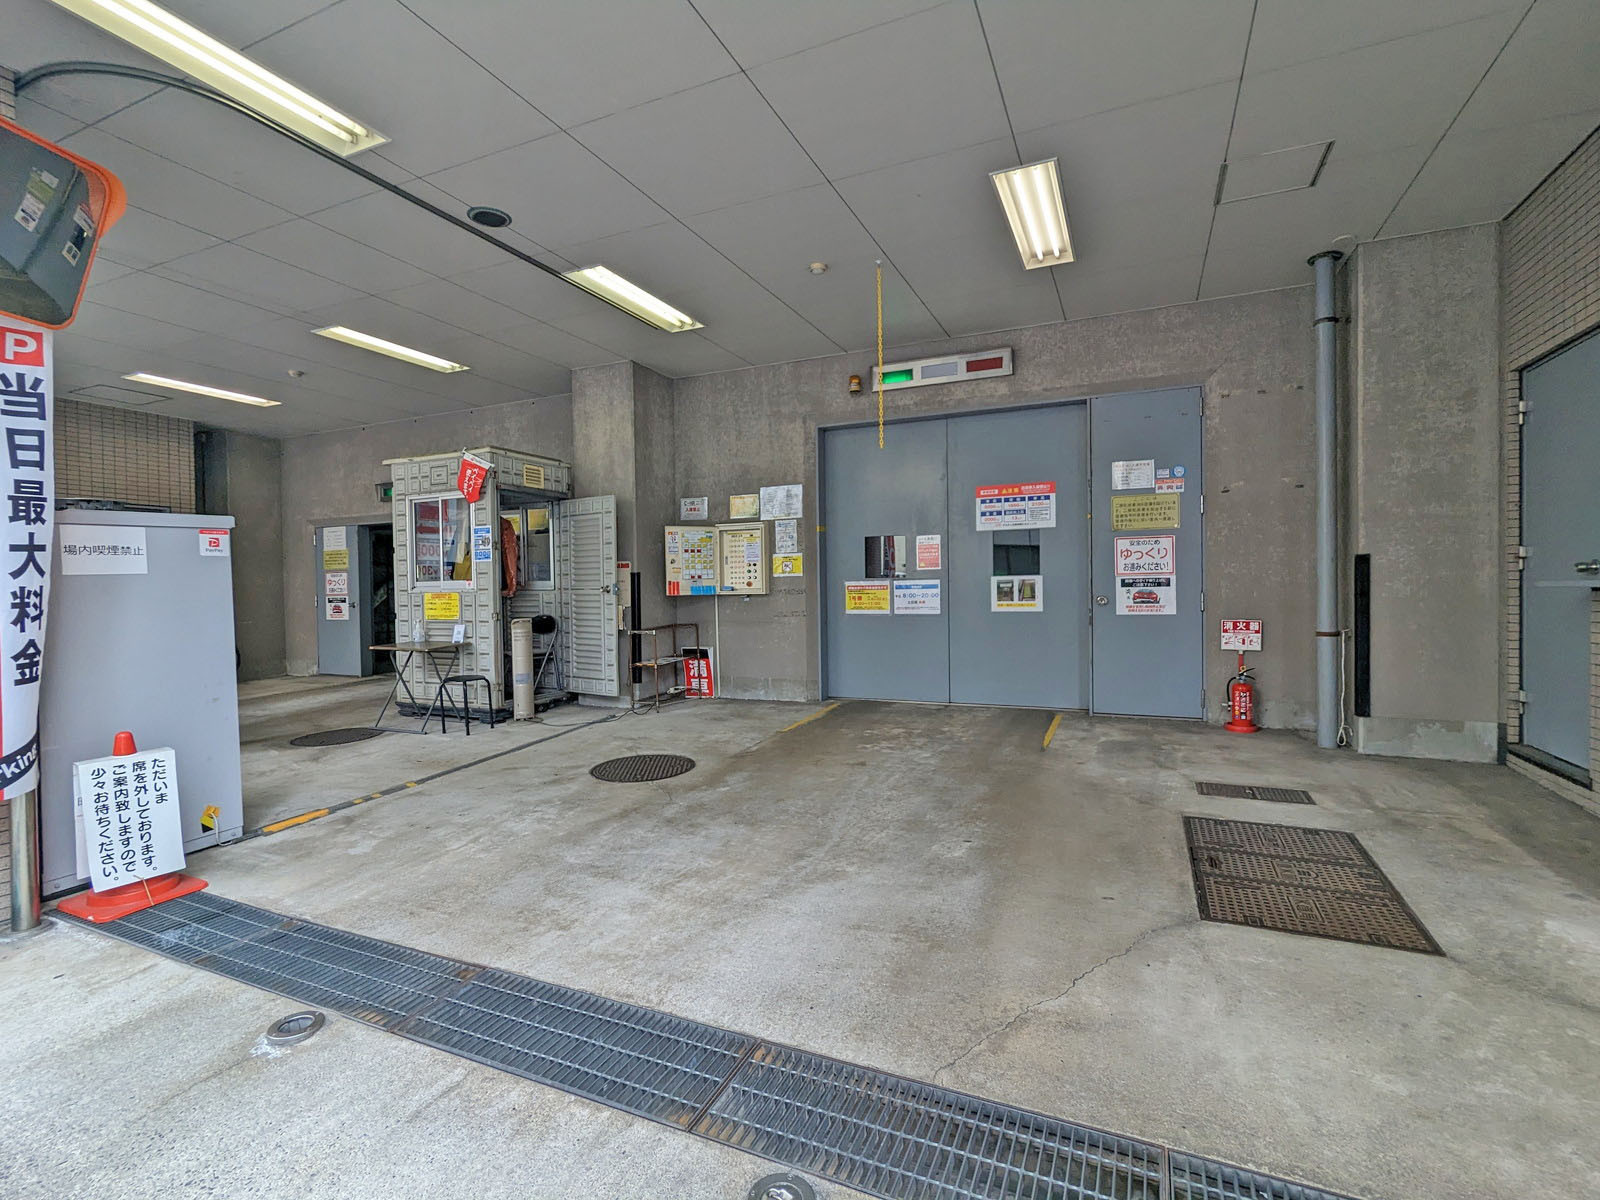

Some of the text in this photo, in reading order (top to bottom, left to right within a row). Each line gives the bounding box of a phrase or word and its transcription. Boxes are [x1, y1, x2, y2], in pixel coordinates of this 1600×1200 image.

[4, 335, 38, 360] P
[0, 371, 48, 687] 当日最大料金
[63, 544, 144, 556] 場内喫煙禁止
[1120, 547, 1168, 560] ゆっくり
[1224, 622, 1260, 630] 消火器
[0, 743, 37, 779] kin
[151, 758, 169, 804] ただいま
[90, 767, 119, 881] 少々お待ちください。
[112, 764, 137, 872] ご案内致しますので
[131, 761, 159, 871] 席を外しております。
